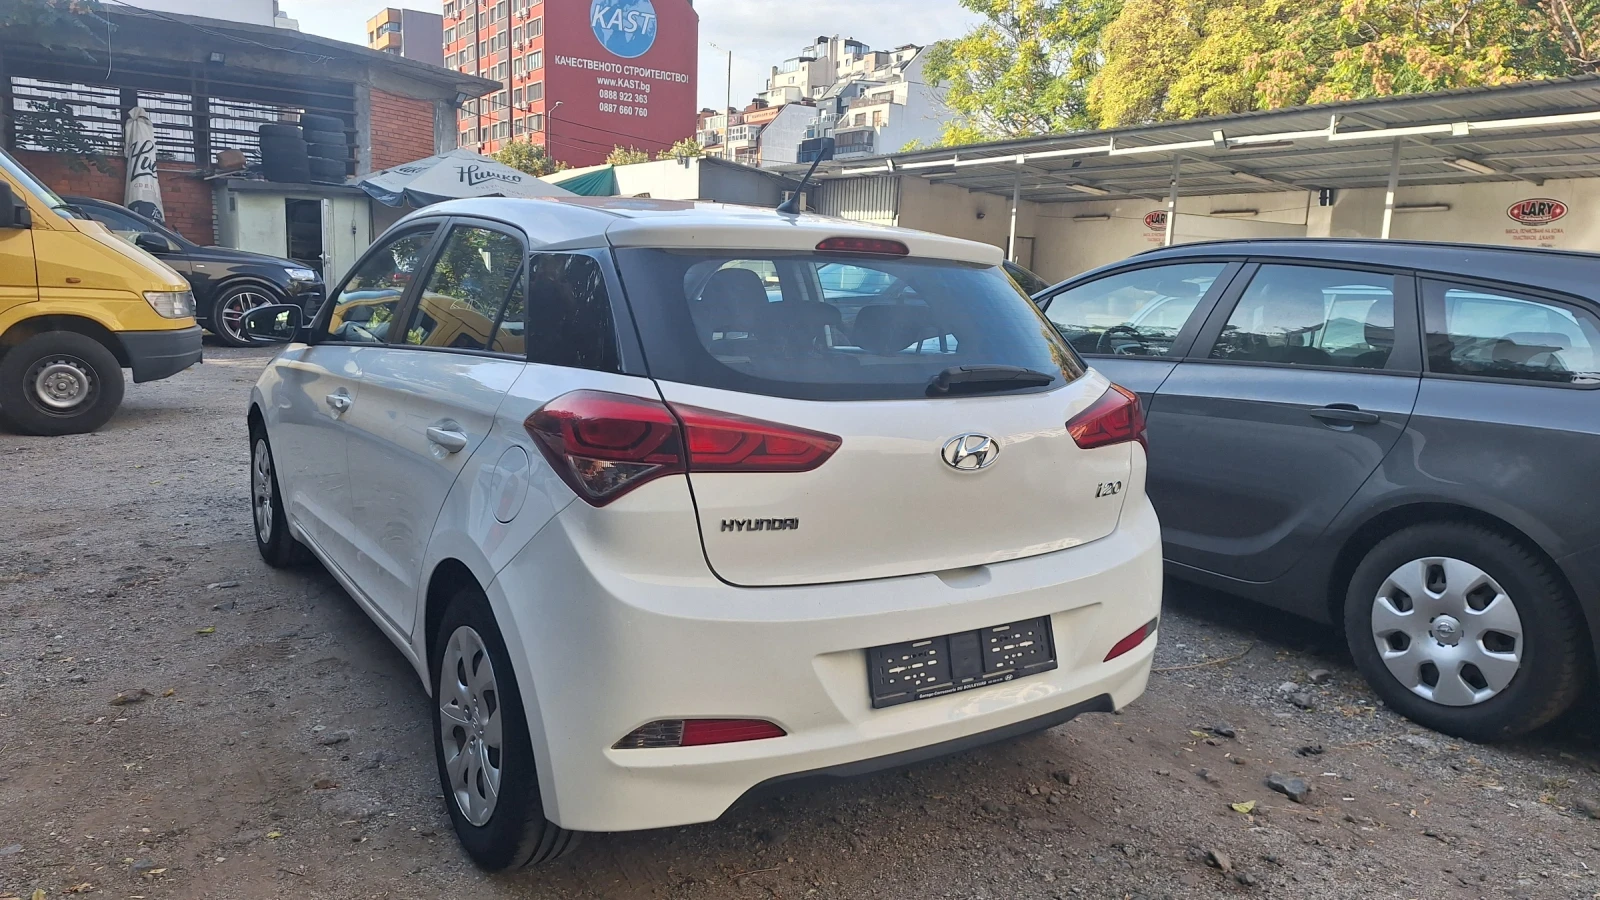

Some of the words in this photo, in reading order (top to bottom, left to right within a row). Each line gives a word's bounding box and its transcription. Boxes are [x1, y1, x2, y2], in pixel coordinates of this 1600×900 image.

[592, 4, 655, 35] KAST
[554, 55, 622, 74] КАЧЕСТВЕНОТО
[623, 65, 689, 84] СТРОИТЕЛСТВО!
[597, 76, 650, 93] www.KAST.bg
[599, 89, 617, 100] 0888
[619, 92, 633, 102] 922
[634, 94, 648, 104] 363
[599, 102, 617, 113] 0887
[619, 105, 633, 115] 660
[634, 107, 648, 117] 760
[1521, 202, 1555, 216] LARY
[1095, 481, 1122, 498] i20
[721, 518, 799, 532] HYUNDAI
